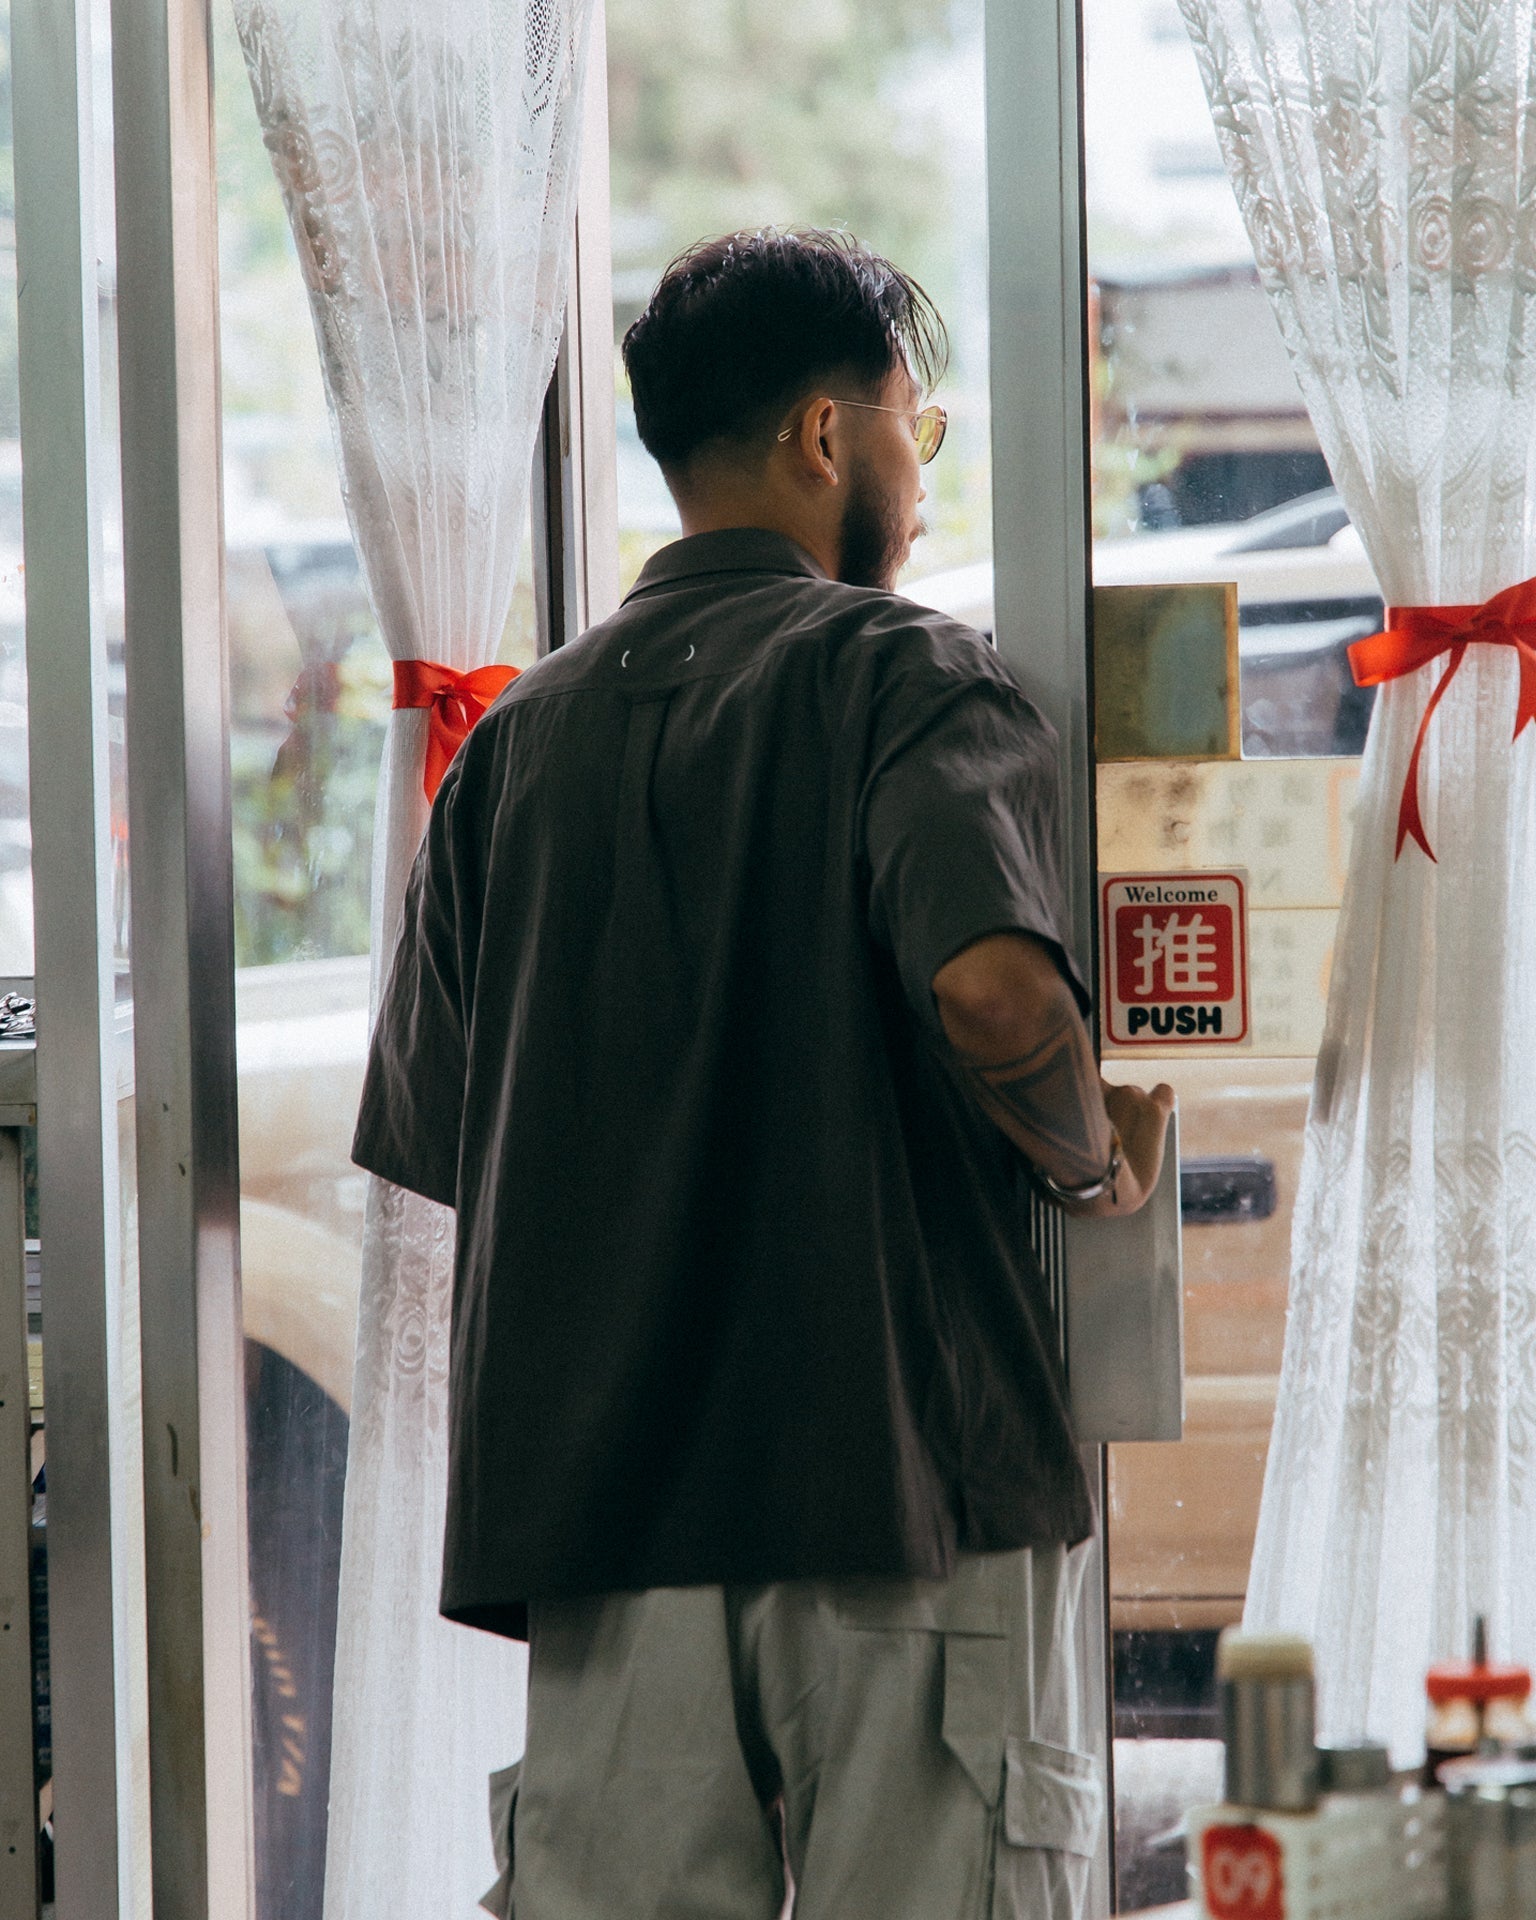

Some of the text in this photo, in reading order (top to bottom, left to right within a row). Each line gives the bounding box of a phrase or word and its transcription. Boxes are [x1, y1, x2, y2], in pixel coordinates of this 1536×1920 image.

[1124, 886, 1218, 903] Welcome
[1132, 912, 1218, 995] 推
[1127, 1005, 1222, 1035] PUSH
